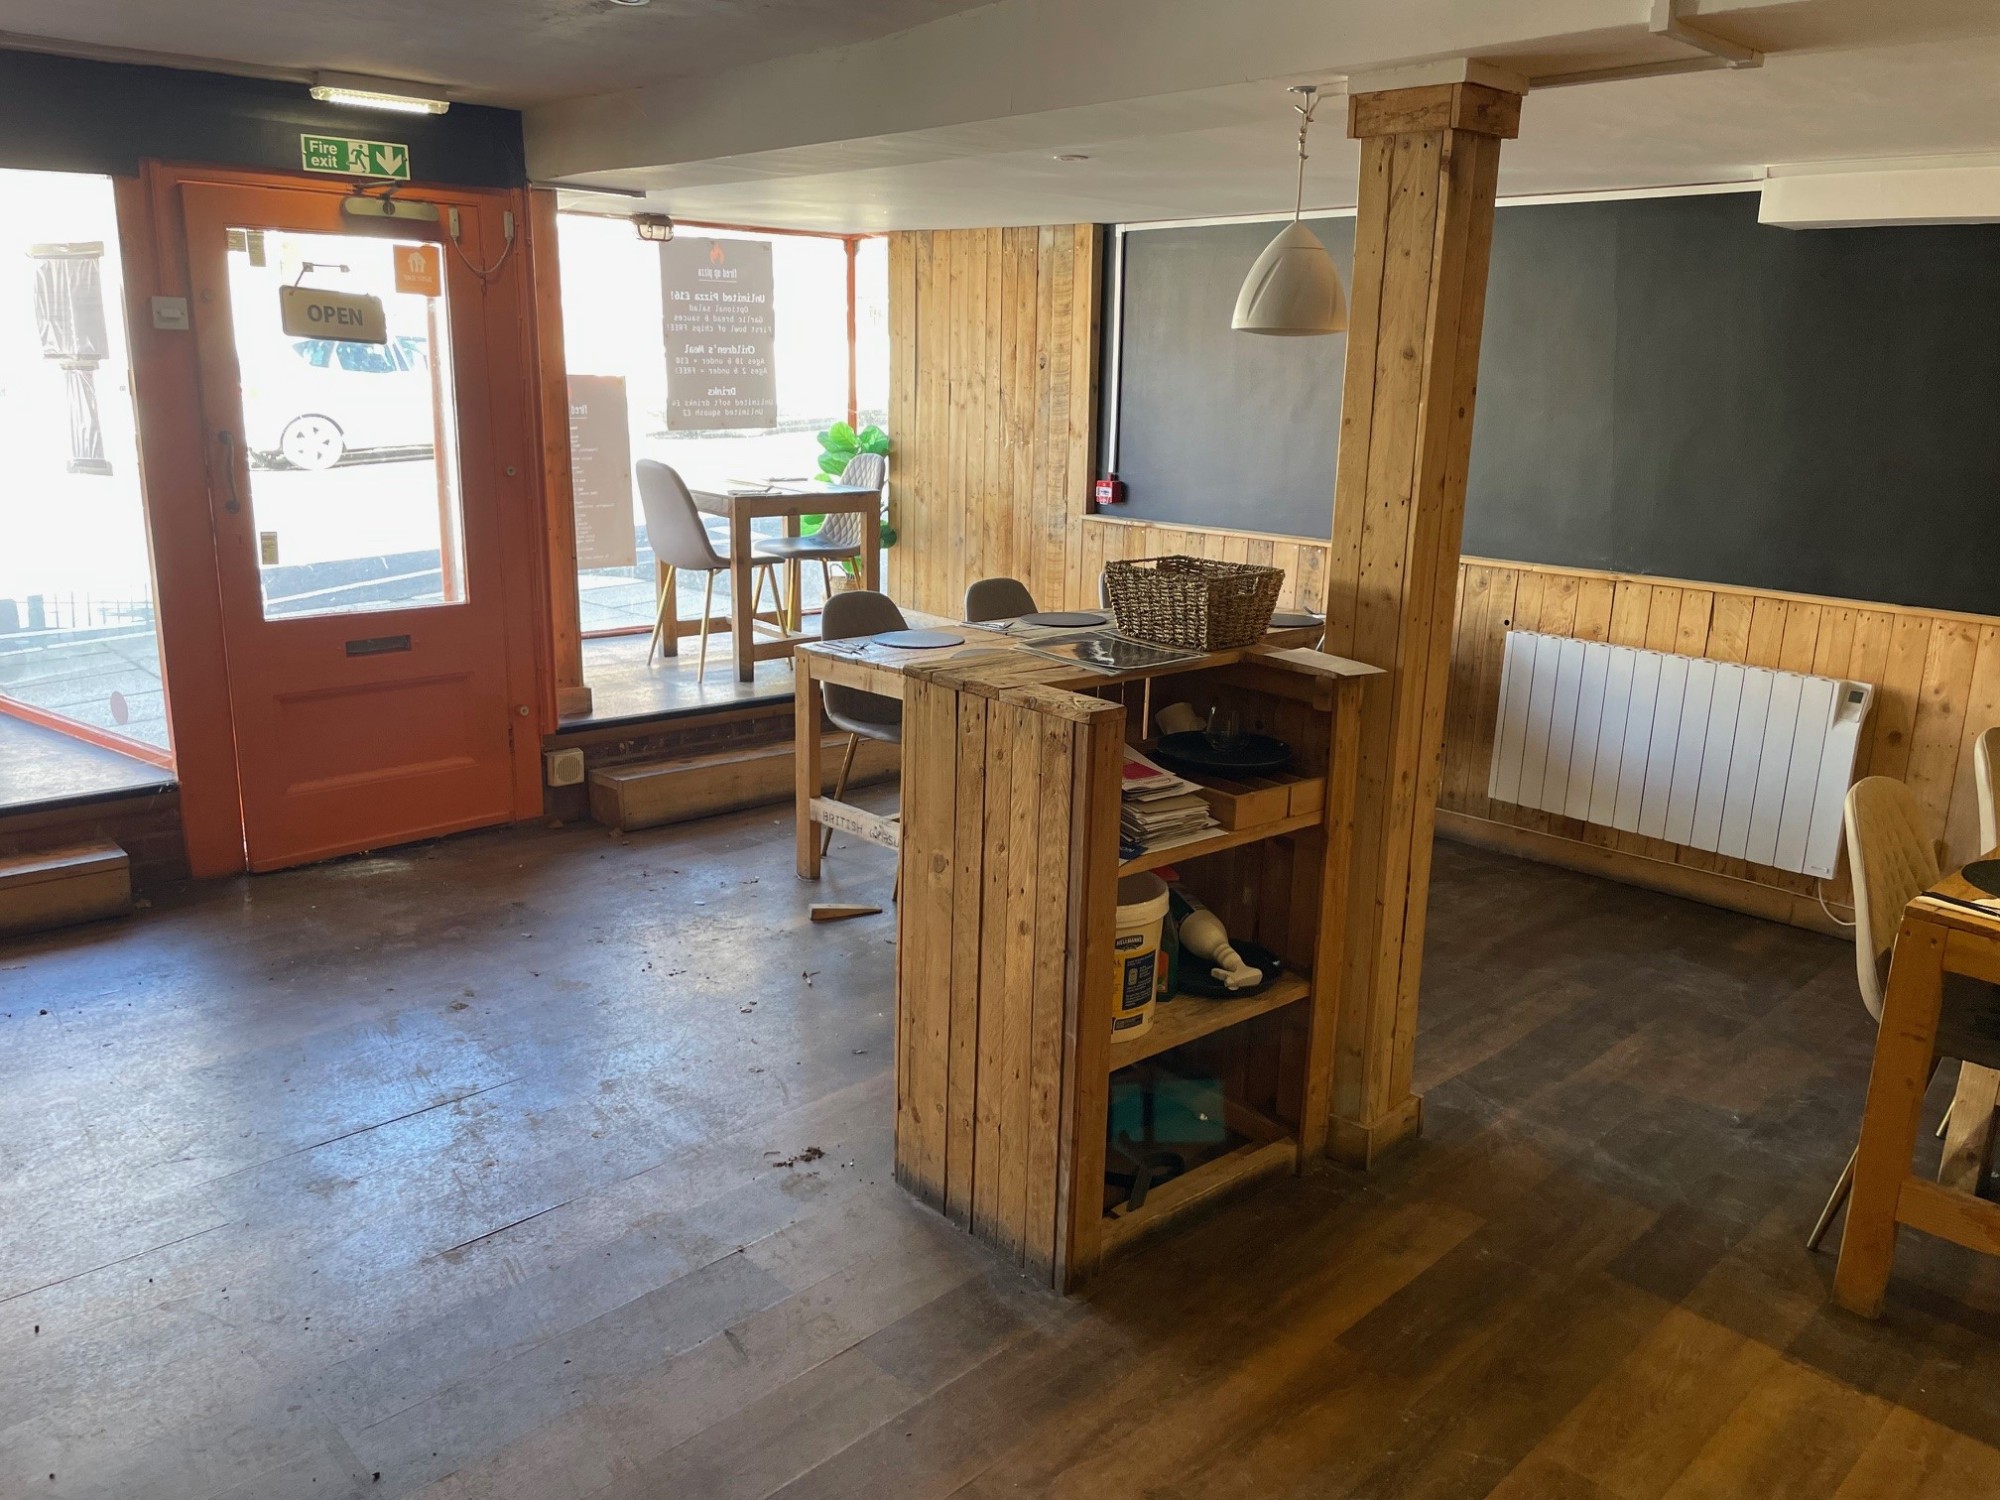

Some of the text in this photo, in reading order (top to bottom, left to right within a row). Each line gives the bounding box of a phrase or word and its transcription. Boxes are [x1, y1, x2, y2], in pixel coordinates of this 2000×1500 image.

[309, 140, 337, 155] Fire
[311, 155, 338, 169] exit
[307, 304, 363, 326] OPEN
[823, 811, 863, 833] BRITISH
